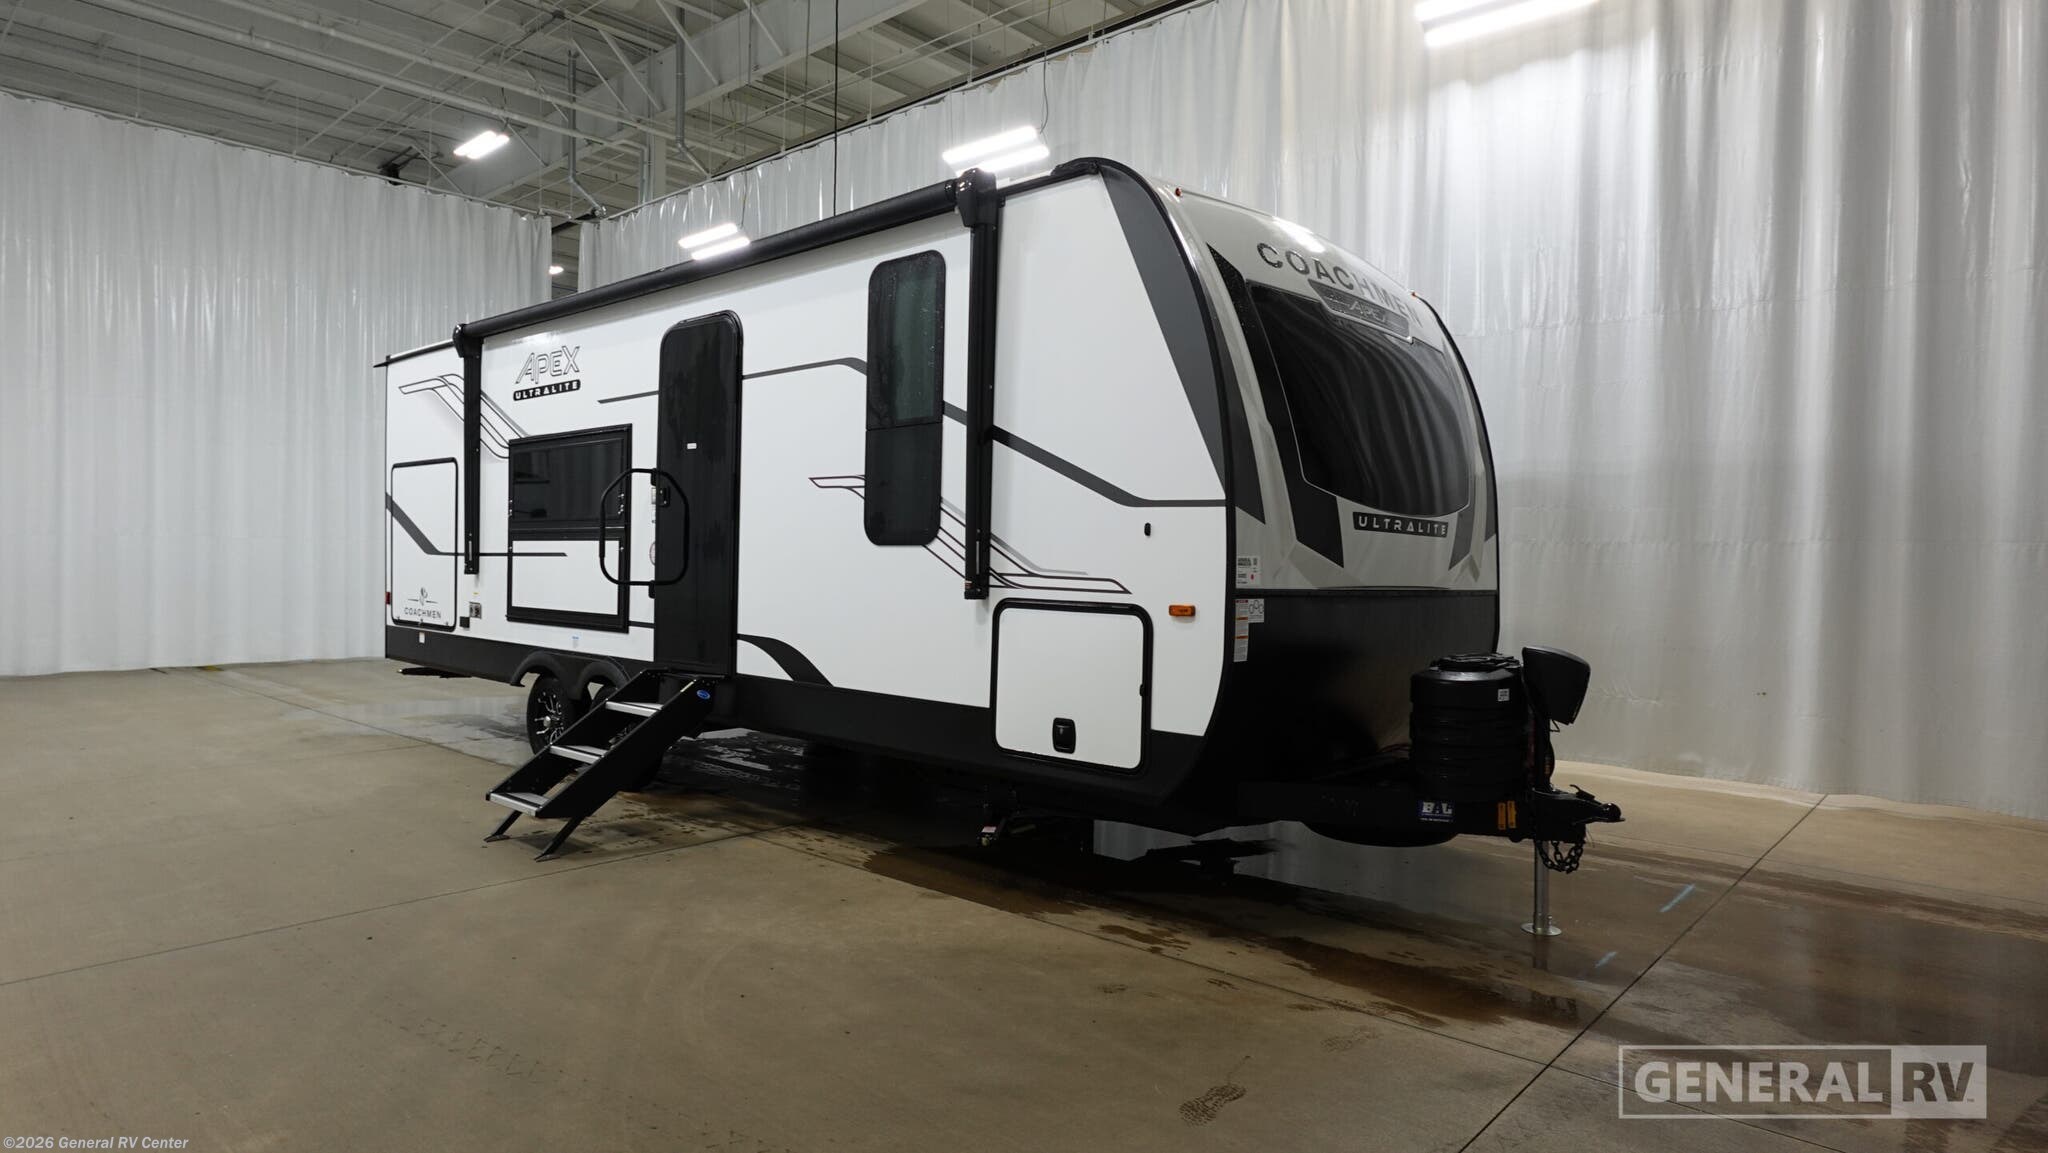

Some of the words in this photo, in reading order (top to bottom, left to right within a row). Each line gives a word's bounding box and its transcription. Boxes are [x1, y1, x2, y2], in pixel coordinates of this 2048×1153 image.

[1256, 242, 1424, 328] COACHMEN
[514, 381, 579, 400] ULTRALITE
[1358, 515, 1446, 535] ULTRALITE
[403, 606, 442, 619] COACHMEN
